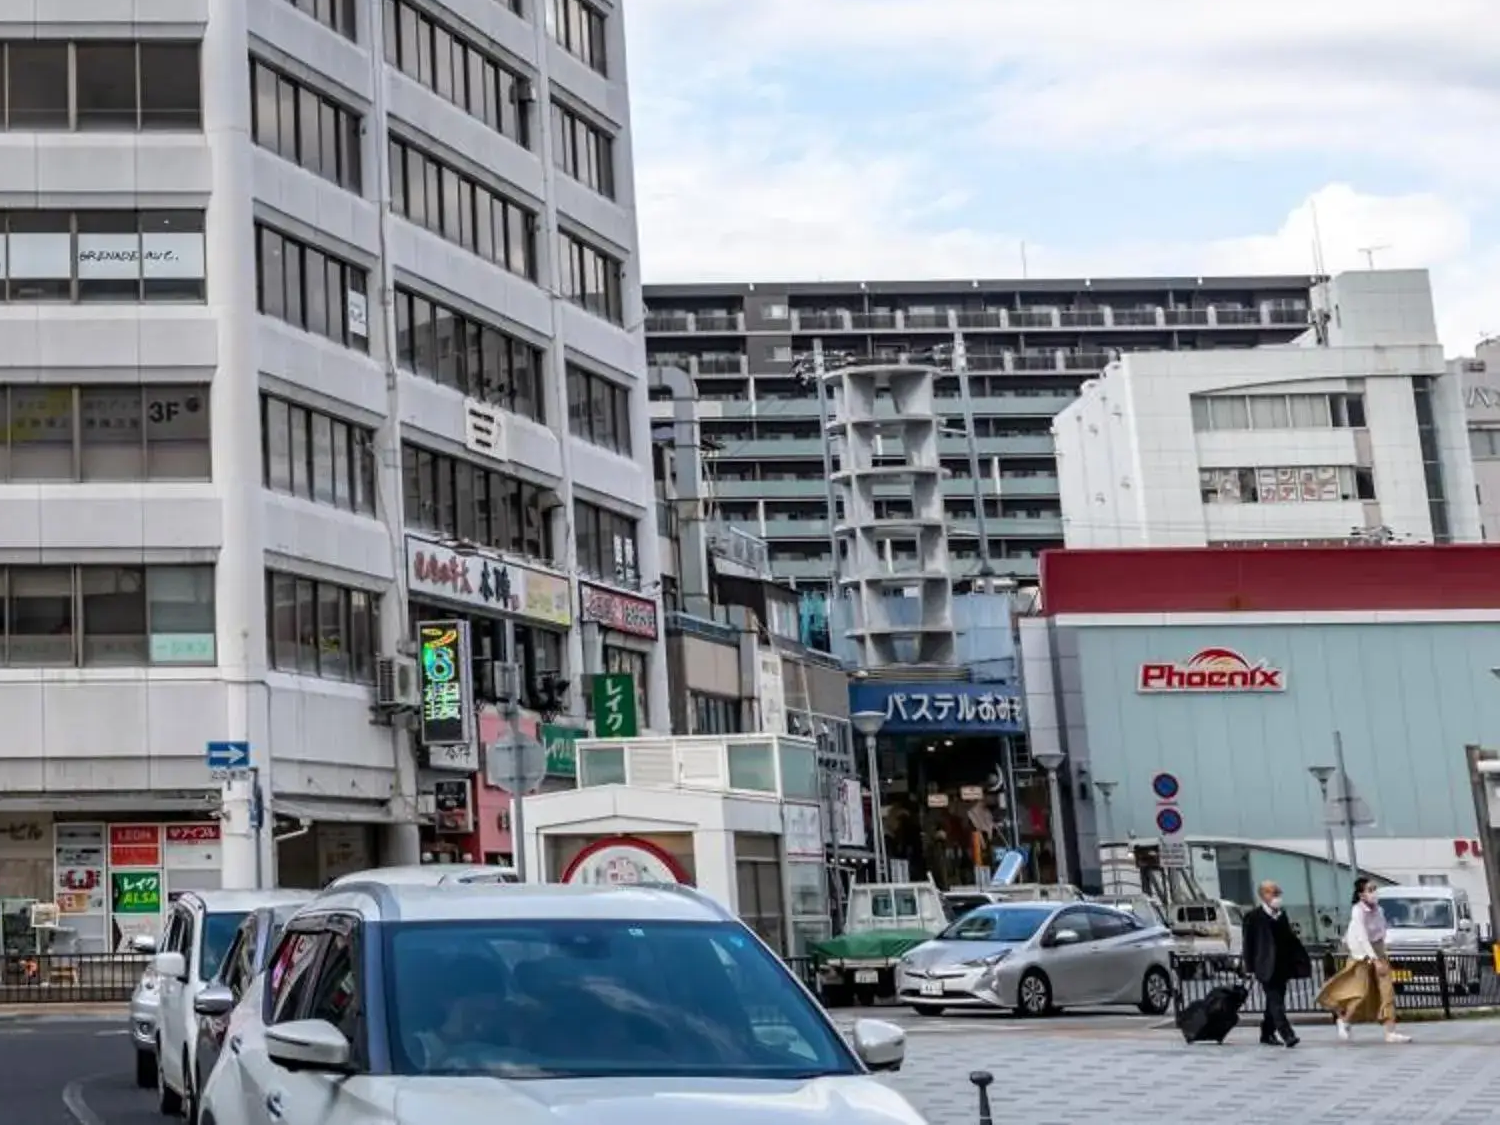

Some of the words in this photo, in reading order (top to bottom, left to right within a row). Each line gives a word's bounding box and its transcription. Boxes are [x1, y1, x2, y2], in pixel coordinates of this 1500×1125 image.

[150, 401, 180, 423] 3F
[1142, 664, 1281, 687] Phoenix
[605, 678, 623, 732] レイク
[123, 877, 157, 890] レイク
